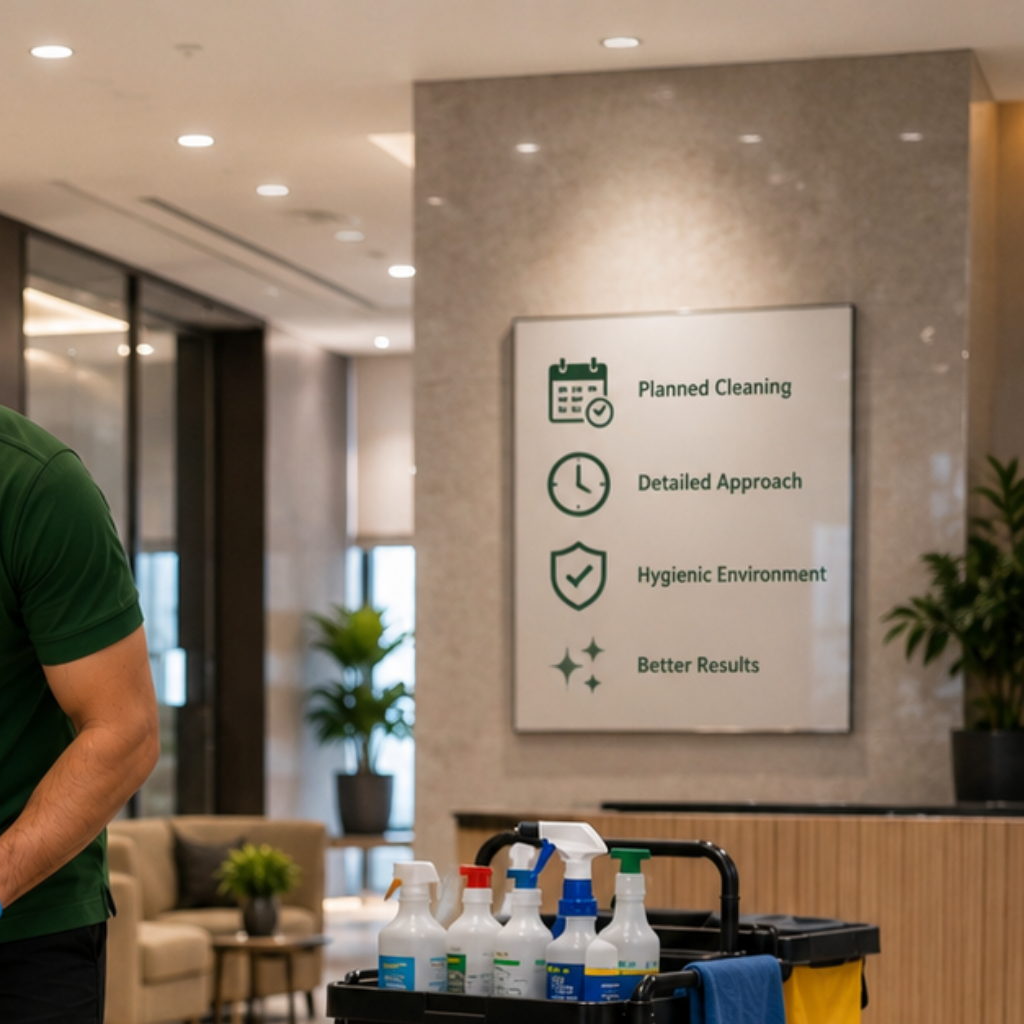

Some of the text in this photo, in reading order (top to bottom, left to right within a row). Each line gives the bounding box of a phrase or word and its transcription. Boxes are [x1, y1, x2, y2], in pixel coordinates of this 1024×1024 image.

[638, 378, 792, 398] Planned Cleaning
[638, 472, 803, 494] Detailed Approach
[637, 565, 827, 587] Hygienic Environment
[637, 656, 760, 674] Better Results
